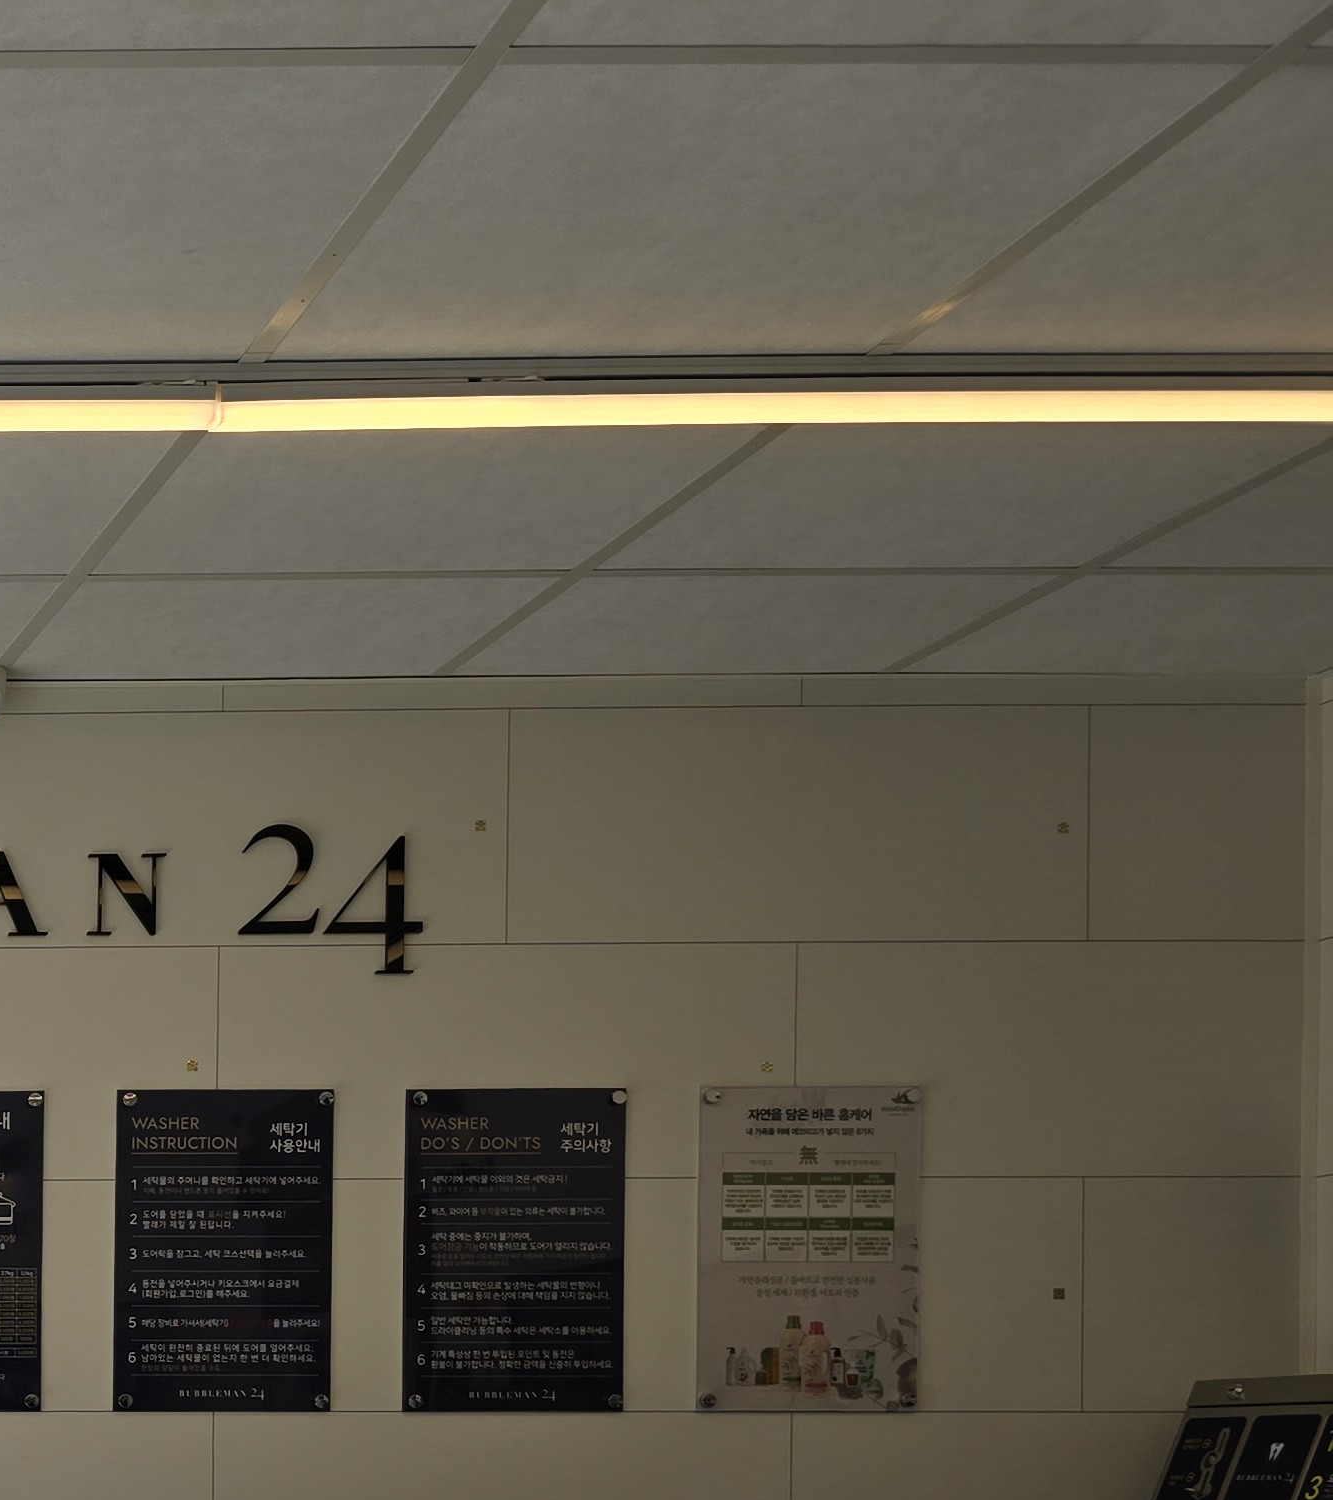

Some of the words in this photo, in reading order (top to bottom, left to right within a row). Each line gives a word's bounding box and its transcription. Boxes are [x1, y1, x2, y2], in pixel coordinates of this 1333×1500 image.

[239, 820, 426, 978] 24
[786, 1108, 809, 1121] 담은
[132, 1117, 199, 1130] WASHER
[270, 1122, 308, 1137] 세탁기
[420, 1117, 489, 1130] WASHER
[561, 1122, 599, 1136] 세탁기
[132, 1136, 237, 1150] INSTRUCTION
[269, 1138, 321, 1153] 사용안내
[420, 1136, 460, 1150] DO'S
[480, 1136, 541, 1150] DON'TS
[560, 1138, 612, 1153] 주의사항
[131, 1179, 137, 1190] 1
[420, 1178, 426, 1190] 1
[418, 1206, 427, 1218] 2
[129, 1213, 138, 1225] 2
[129, 1247, 138, 1260] 3
[418, 1244, 426, 1256] 3
[128, 1282, 137, 1294] 4
[417, 1283, 426, 1295] 4
[128, 1316, 137, 1328] 5
[417, 1320, 426, 1331] 5
[128, 1352, 137, 1363] 6
[417, 1354, 426, 1366] 6
[179, 1389, 246, 1397] BUBBLEMAN
[251, 1387, 264, 1400] 24
[469, 1390, 537, 1399] BUBBLEMAN
[541, 1389, 555, 1402] 24
[1304, 1475, 1324, 1500] 3
